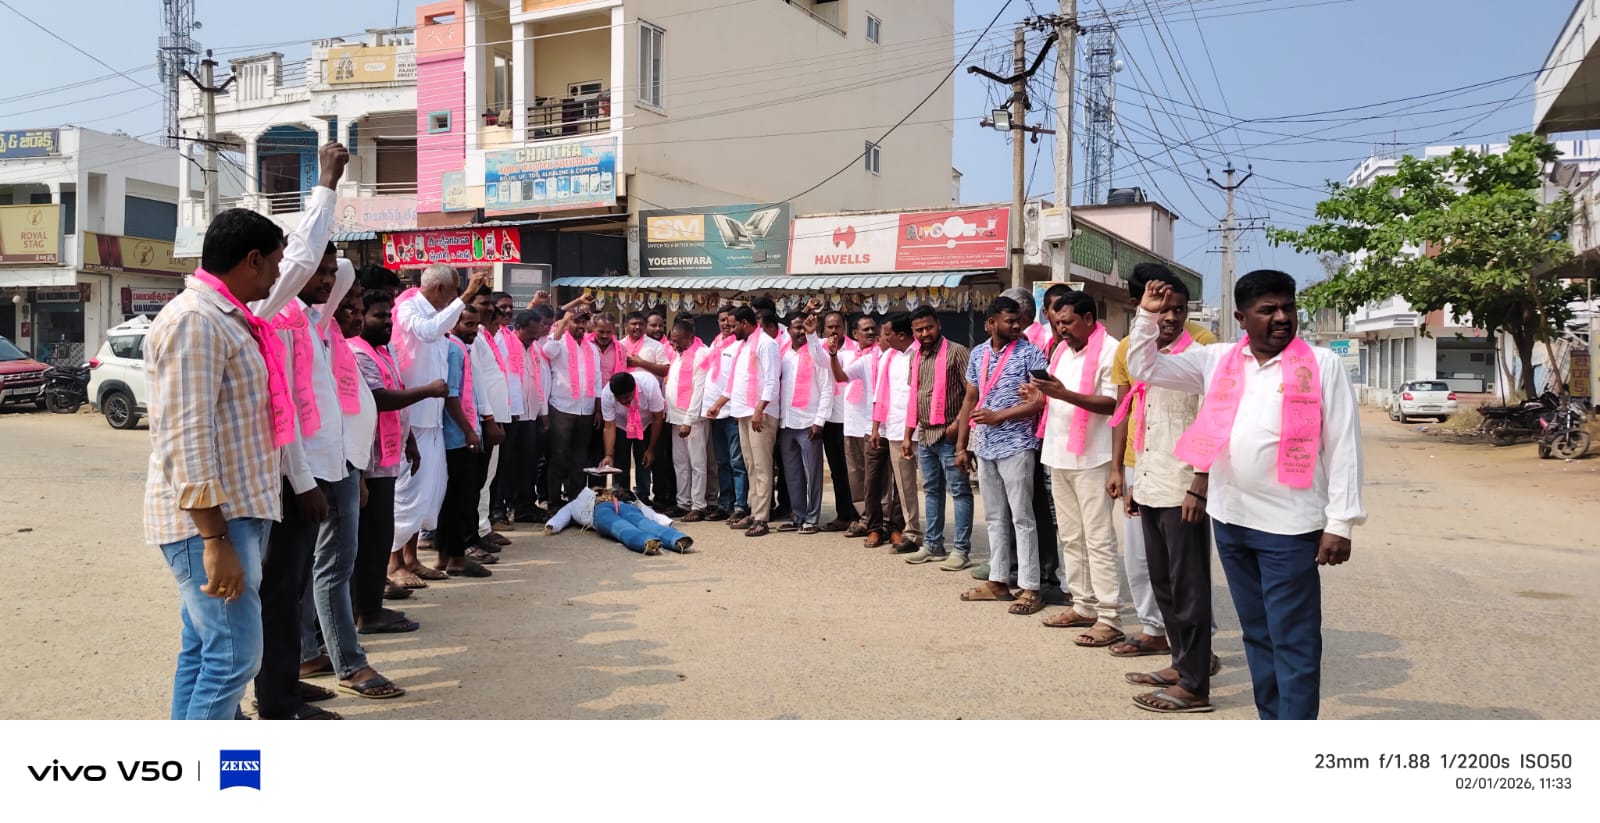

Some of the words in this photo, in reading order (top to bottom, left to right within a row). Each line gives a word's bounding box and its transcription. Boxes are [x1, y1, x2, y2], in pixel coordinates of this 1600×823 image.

[515, 143, 582, 163] CHAITRA
[20, 232, 48, 241] ROYAL
[23, 240, 45, 249] STAG
[648, 256, 712, 266] YOGESHWARA
[814, 253, 871, 265] HAVELLS
